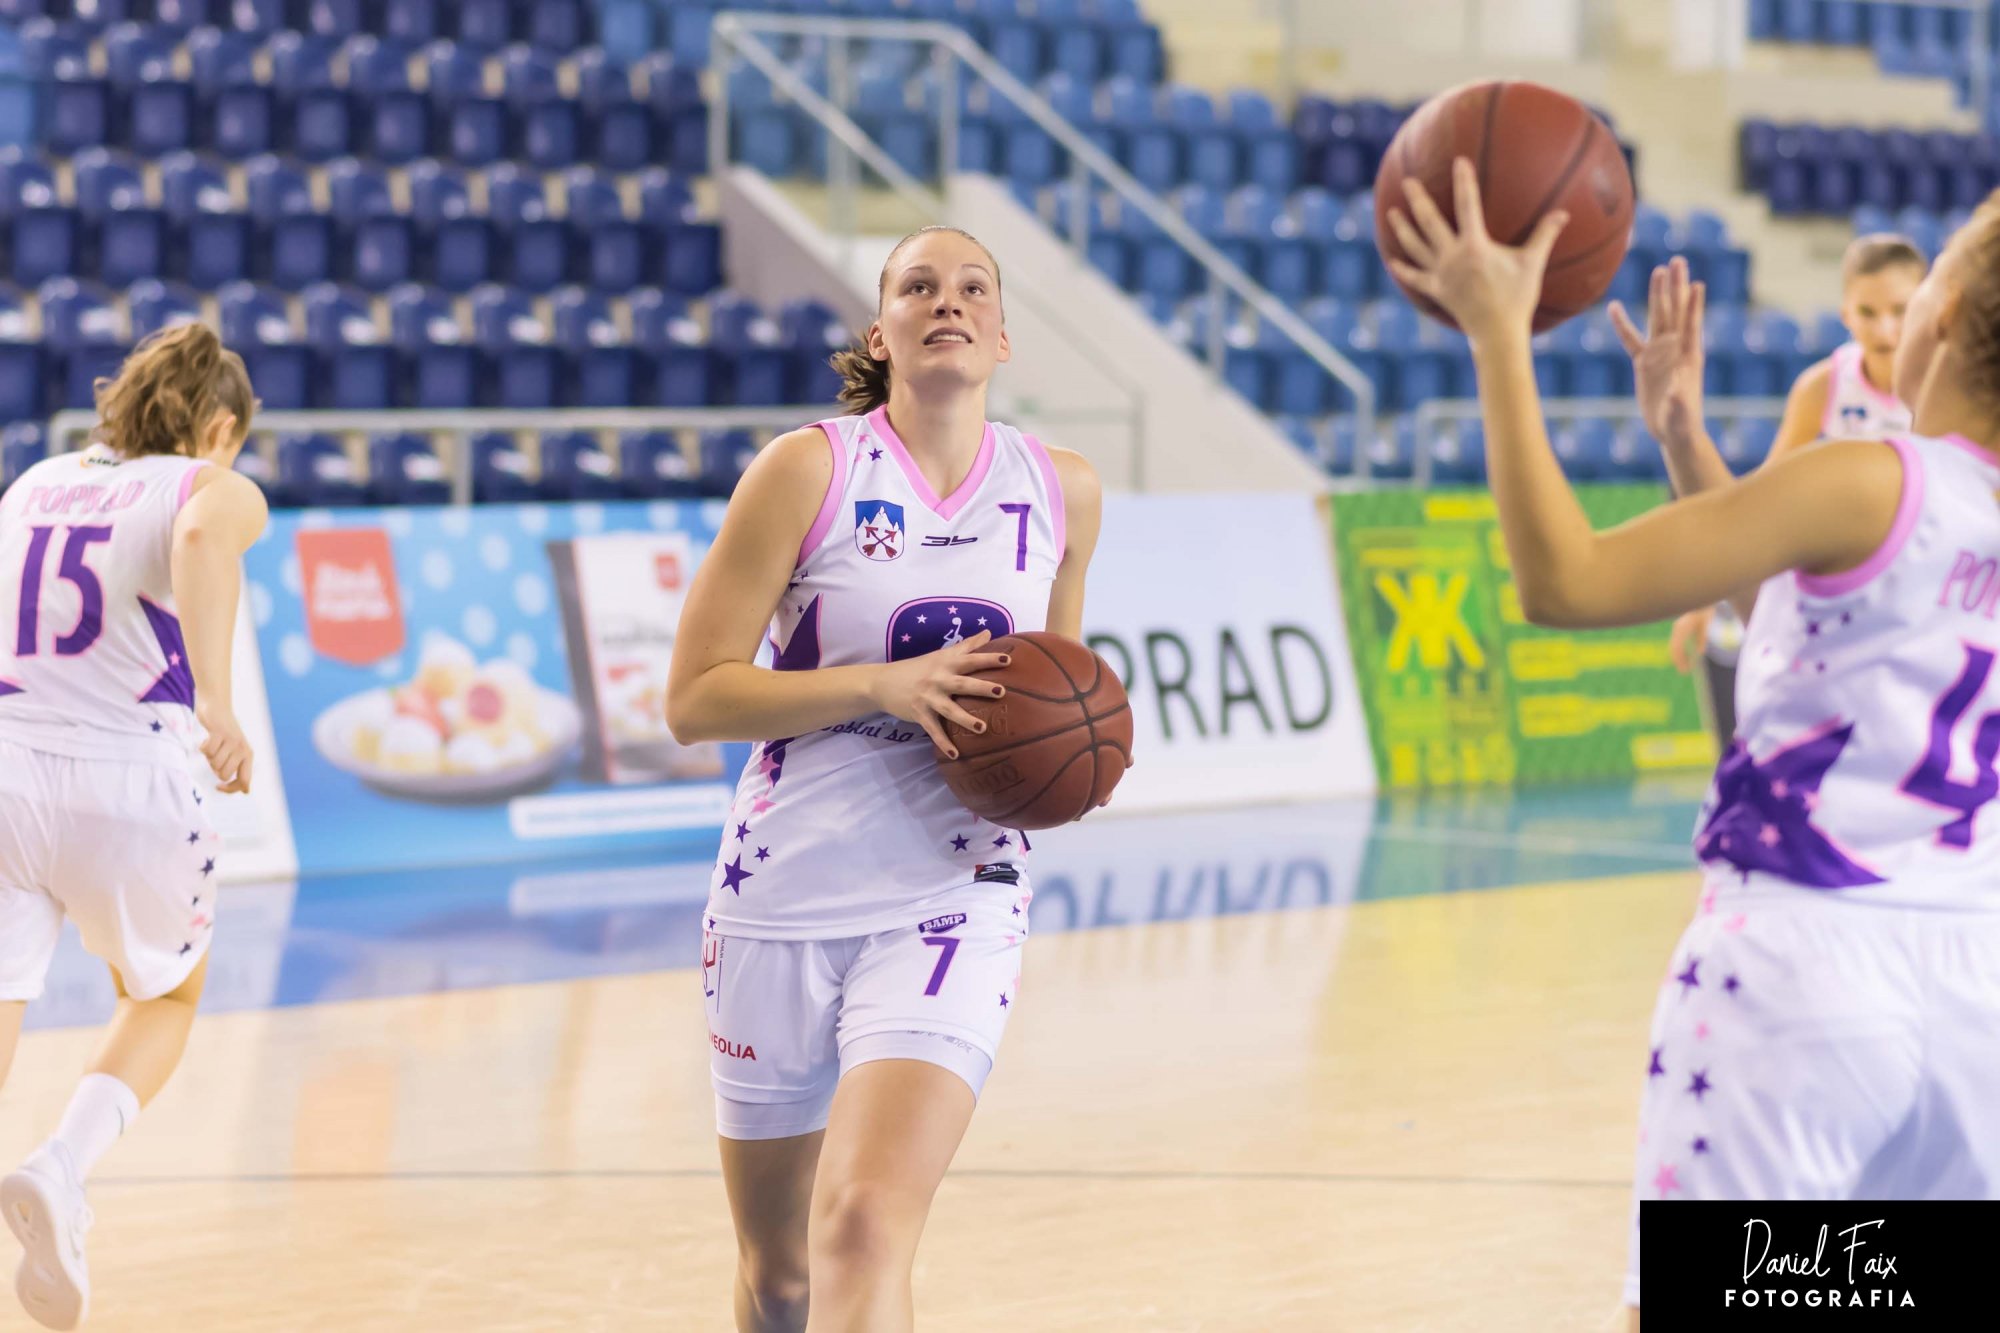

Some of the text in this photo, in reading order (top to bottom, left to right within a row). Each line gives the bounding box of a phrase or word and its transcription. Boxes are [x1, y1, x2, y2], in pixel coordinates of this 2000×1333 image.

[21, 479, 146, 516] POPRAD
[999, 502, 1032, 572] 7
[14, 523, 116, 657] 15
[1088, 622, 1335, 740] PRAD
[922, 915, 964, 931] BAMP
[921, 936, 961, 997] 7
